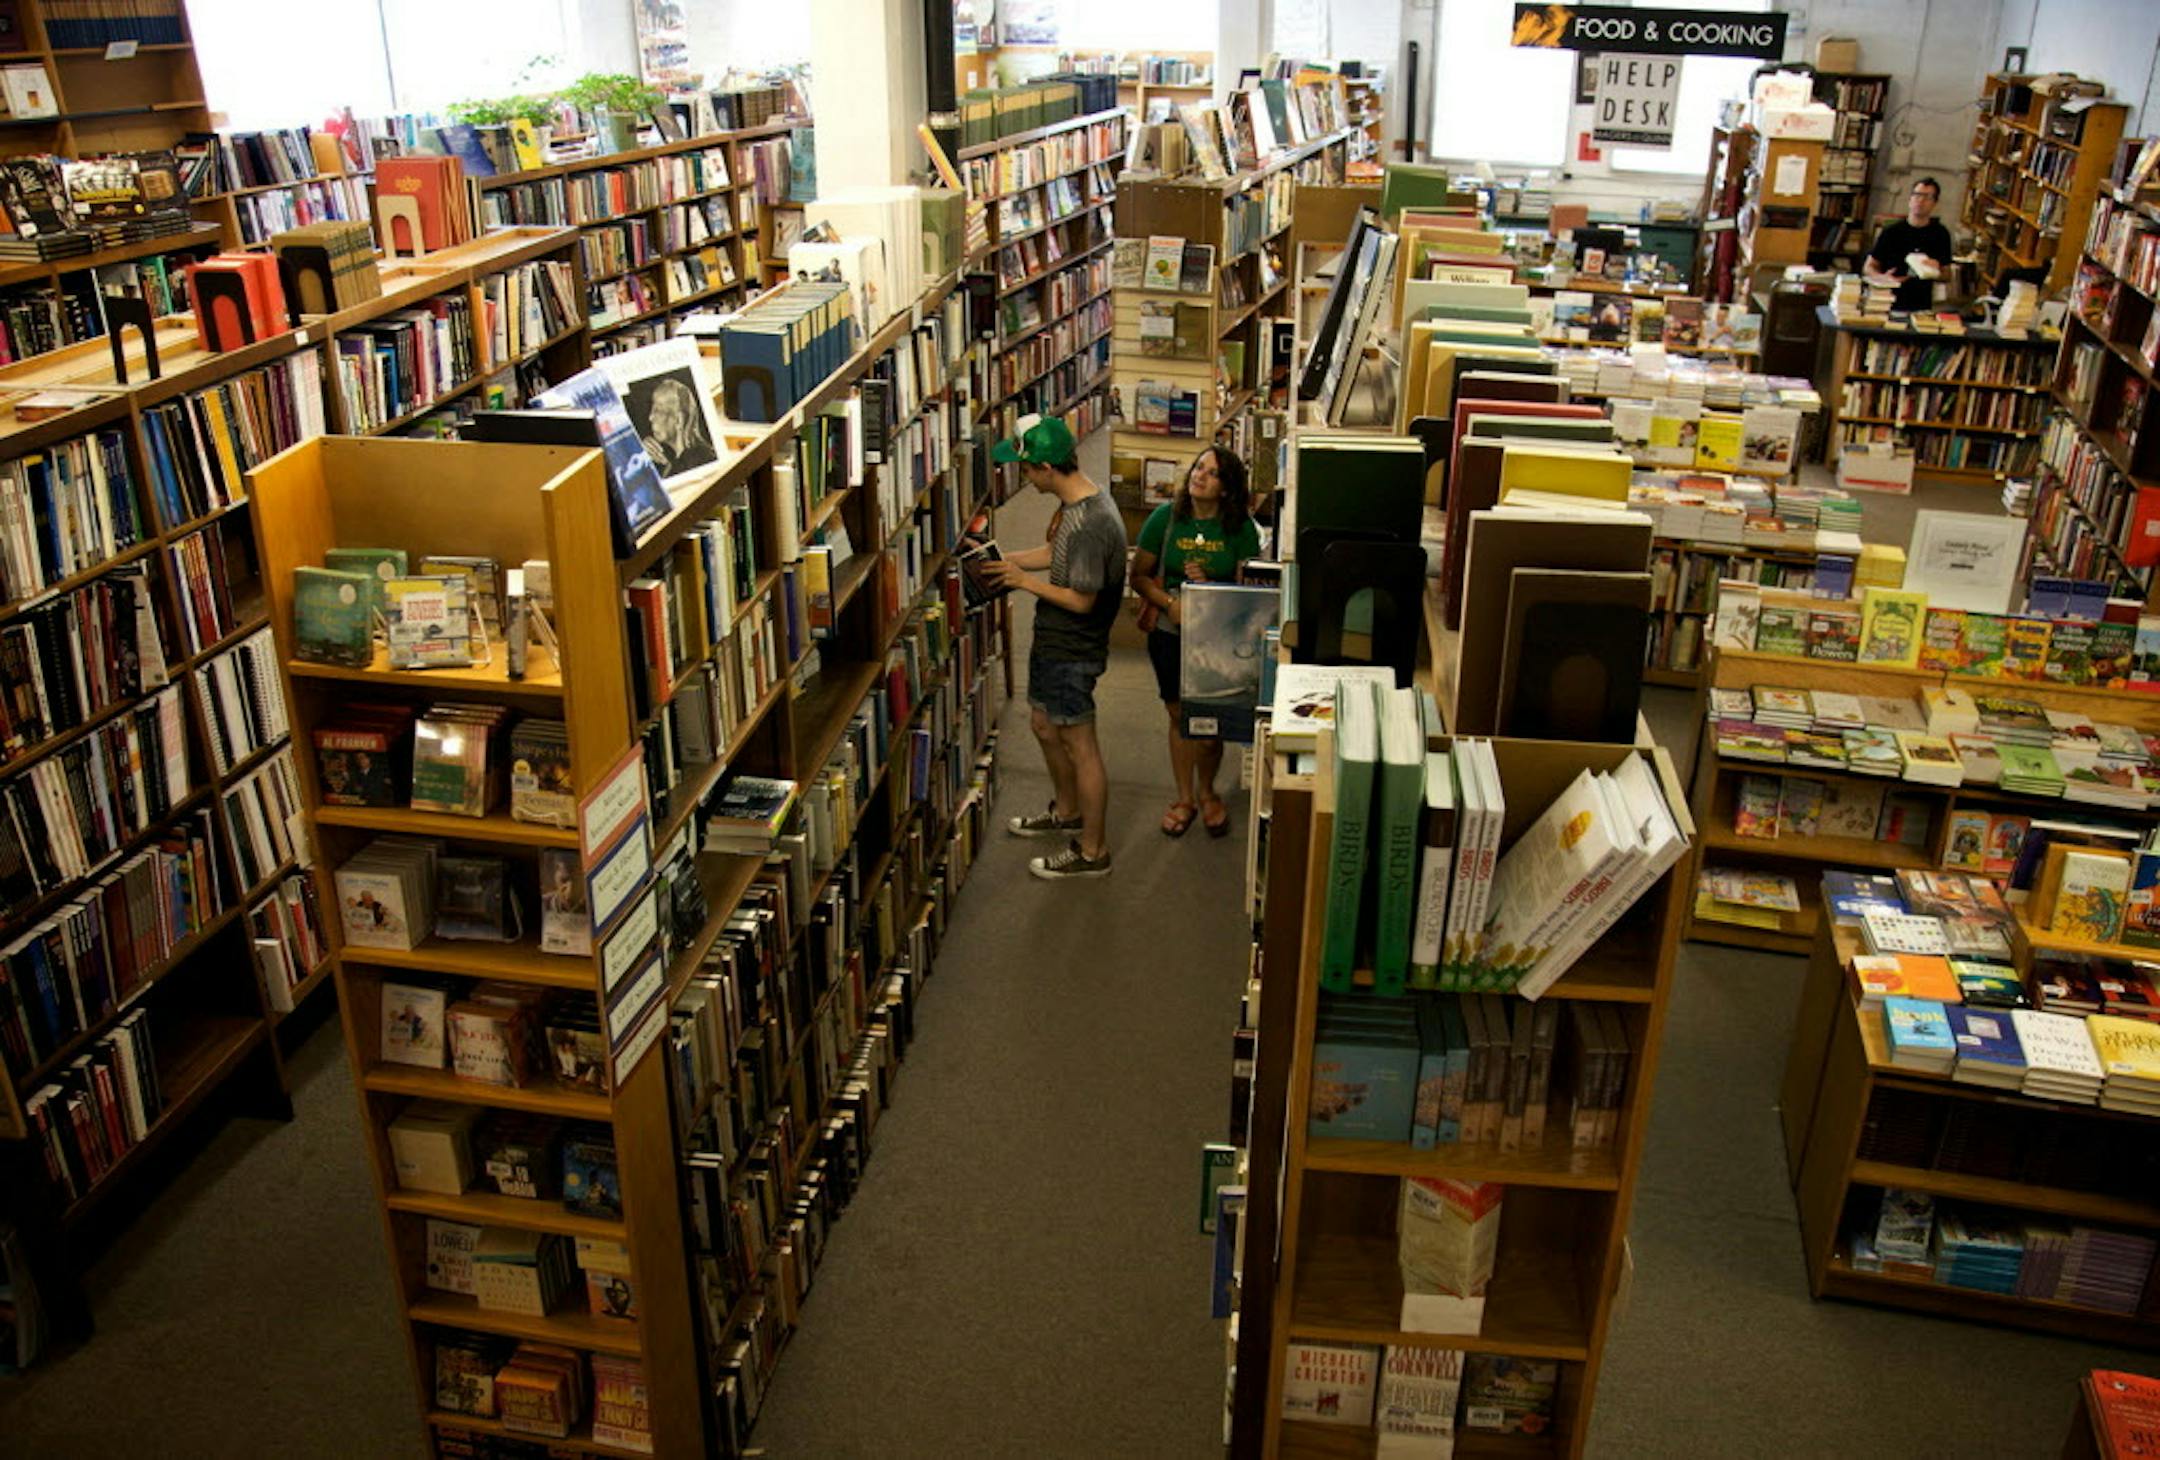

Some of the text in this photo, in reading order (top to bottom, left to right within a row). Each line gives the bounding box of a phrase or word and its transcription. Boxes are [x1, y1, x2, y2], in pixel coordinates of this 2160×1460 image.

[1574, 18, 1774, 46] FOOD & COOKING
[1606, 60, 1676, 88] HELP
[1602, 98, 1669, 126] DESK
[1337, 820, 1361, 887] BIRDS
[1389, 825, 1412, 891] BIRDS
[1459, 848, 1476, 881] BIRDS
[1477, 849, 1494, 881] BIRDS
[1563, 878, 1591, 905] BIRDS
[1582, 875, 1614, 904] BIRDS
[1299, 1349, 1364, 1369] MICHAEL
[1387, 1357, 1459, 1381] CORNWELL
[1294, 1367, 1366, 1385] CRICHTON
